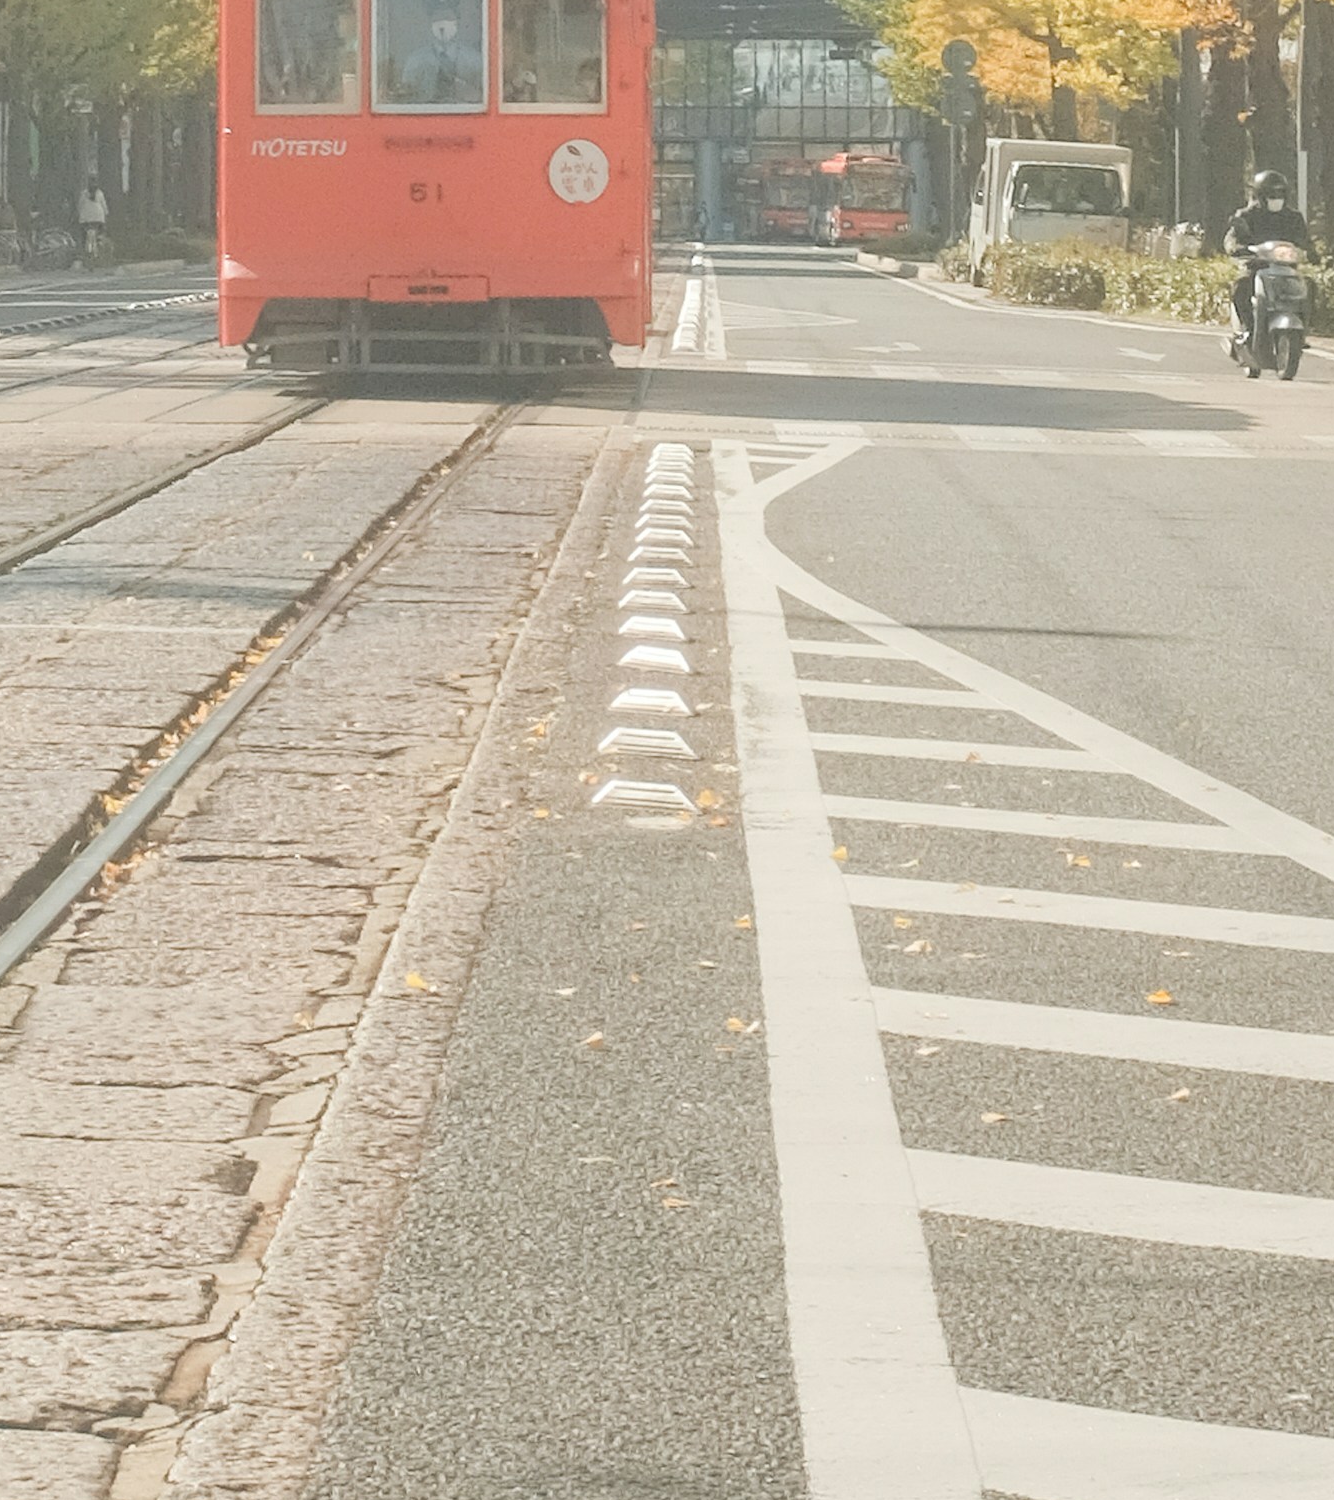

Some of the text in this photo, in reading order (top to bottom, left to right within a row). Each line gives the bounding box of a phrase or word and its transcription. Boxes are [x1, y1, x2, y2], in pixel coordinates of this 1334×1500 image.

[250, 136, 348, 158] IYOTETSU
[559, 161, 599, 175] みかん
[409, 181, 444, 203] 51
